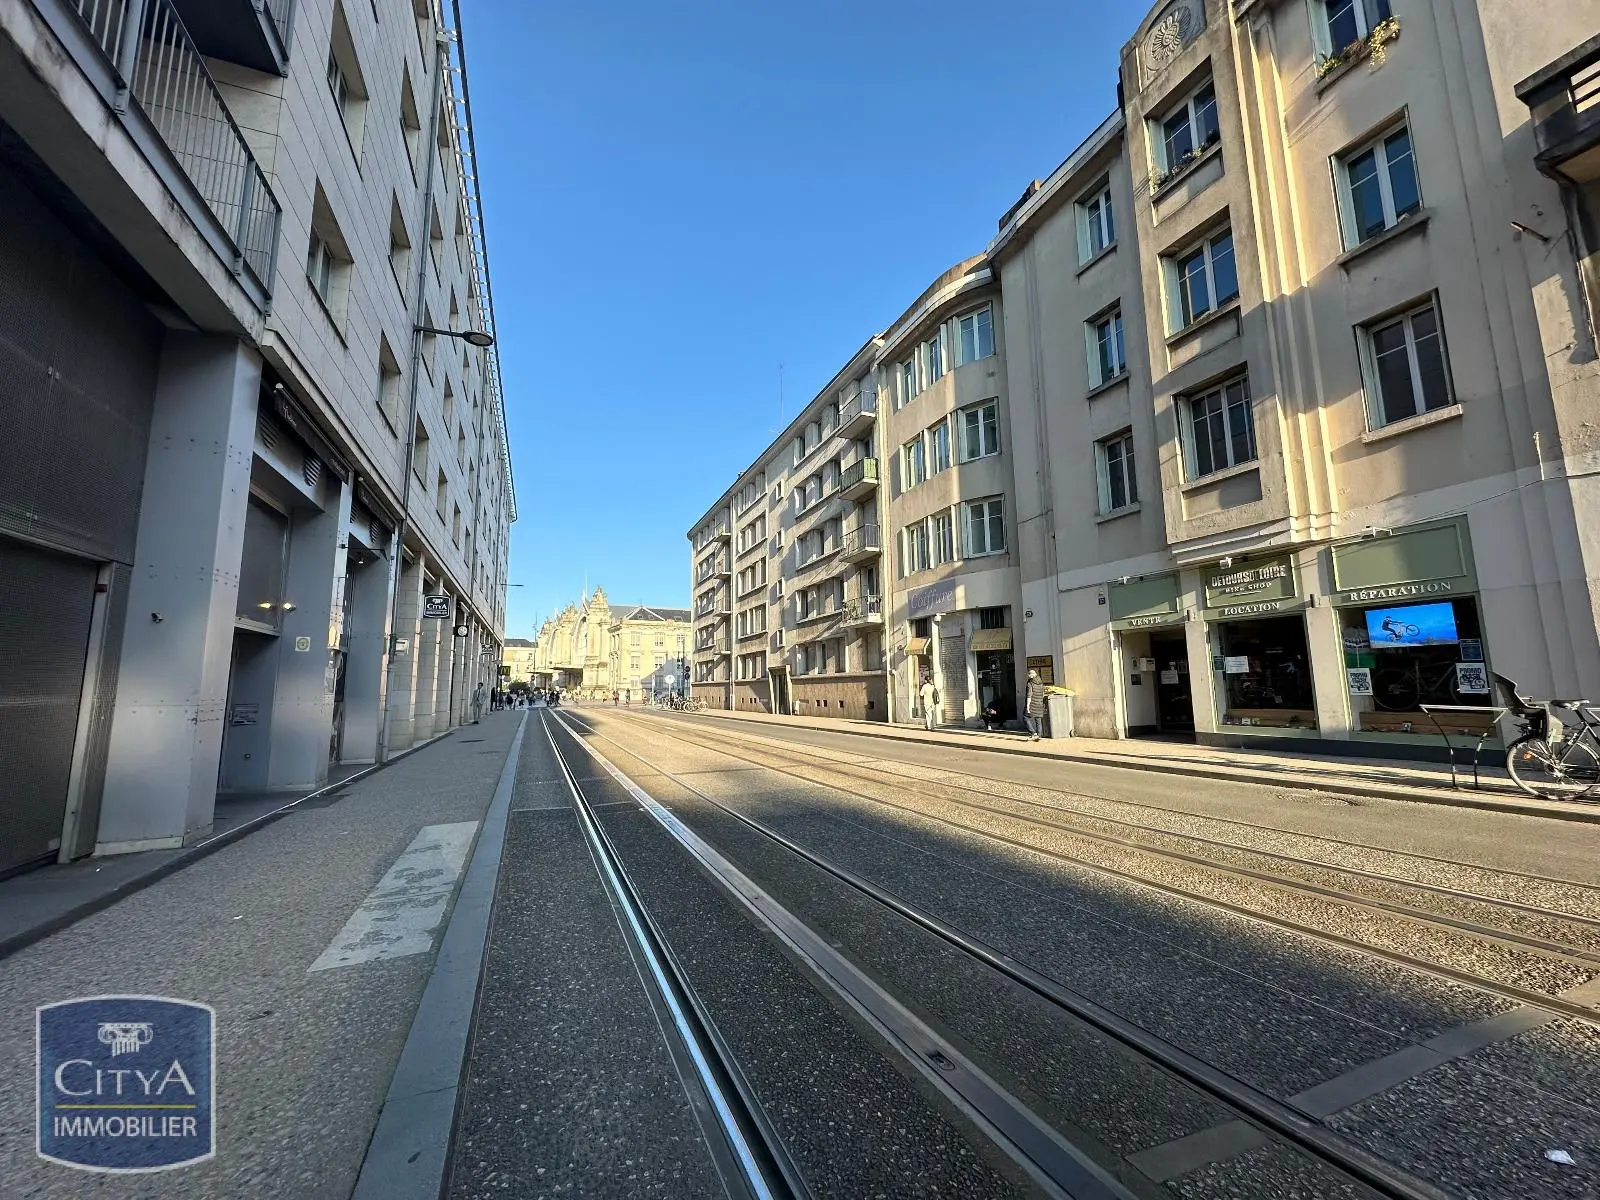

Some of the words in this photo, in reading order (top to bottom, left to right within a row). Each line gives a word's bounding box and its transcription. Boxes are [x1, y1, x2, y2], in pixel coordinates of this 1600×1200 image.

[1211, 571, 1249, 587] DETOURS
[1247, 581, 1272, 590] SHOP
[1350, 581, 1451, 601] RÉPARATION
[911, 589, 953, 610] Coiffure
[1224, 601, 1280, 615] LOCATION
